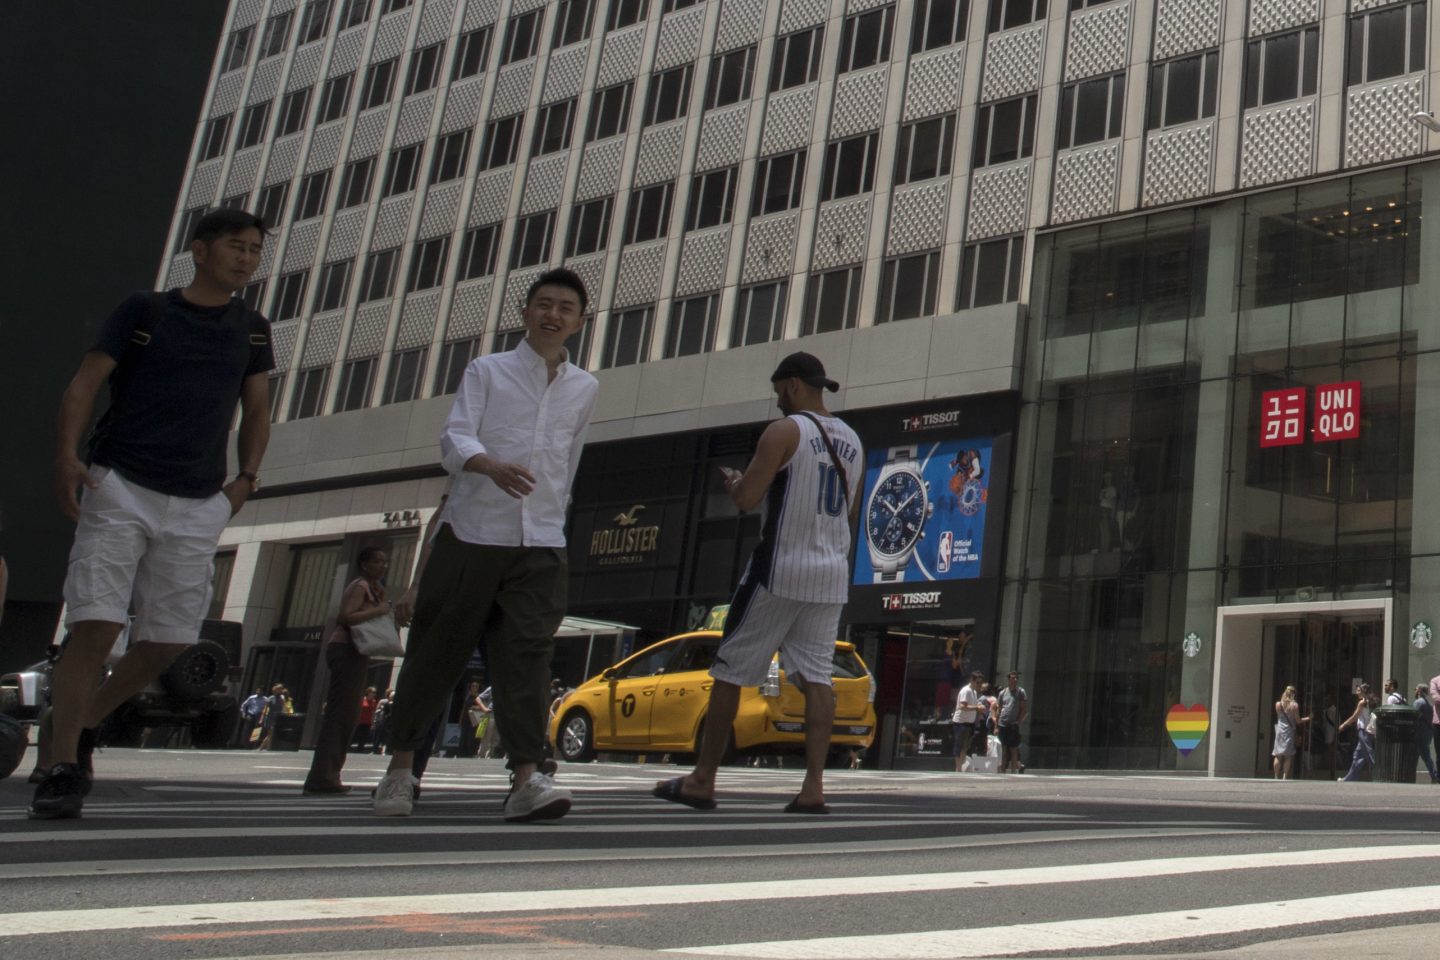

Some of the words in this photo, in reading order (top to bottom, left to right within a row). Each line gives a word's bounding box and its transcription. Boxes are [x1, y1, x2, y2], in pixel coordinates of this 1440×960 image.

[1267, 394, 1300, 417] ユニ
[1320, 388, 1353, 411] UNI
[922, 410, 960, 426] TISSOT
[1265, 418, 1299, 440] クロ
[1319, 411, 1355, 437] QLO
[810, 437, 857, 464] FOUNIER
[817, 461, 843, 518] 10
[383, 509, 421, 523] ZARA
[590, 525, 659, 555] HOLLISTER
[953, 539, 972, 548] Official
[953, 547, 969, 555] Watch
[902, 591, 942, 605] TISSOT
